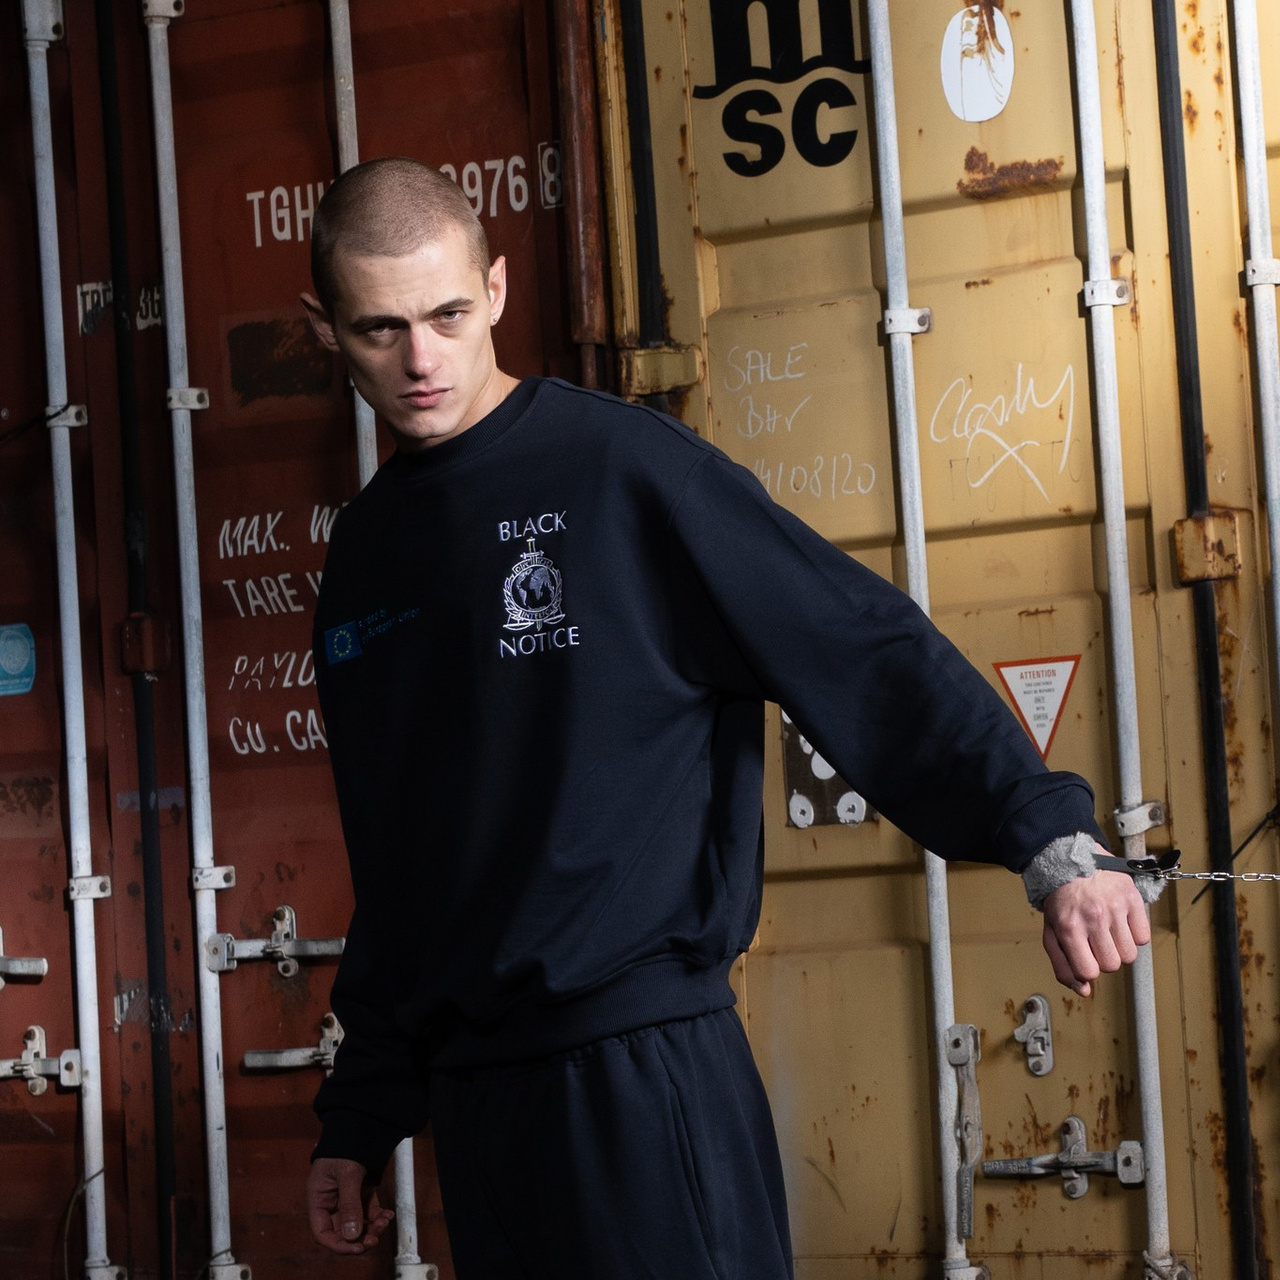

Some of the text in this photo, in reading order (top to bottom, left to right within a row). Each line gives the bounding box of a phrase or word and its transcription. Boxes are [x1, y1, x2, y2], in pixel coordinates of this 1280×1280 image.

[246, 179, 334, 248] TGH
[539, 144, 562, 208] 8
[724, 342, 809, 392] SALE
[498, 510, 567, 542] BLACK
[222, 572, 305, 618] TARE
[499, 626, 581, 659] NOTICE
[228, 648, 318, 692] PAYLO
[1019, 669, 1057, 680] ATTENTION
[286, 708, 329, 752] CA
